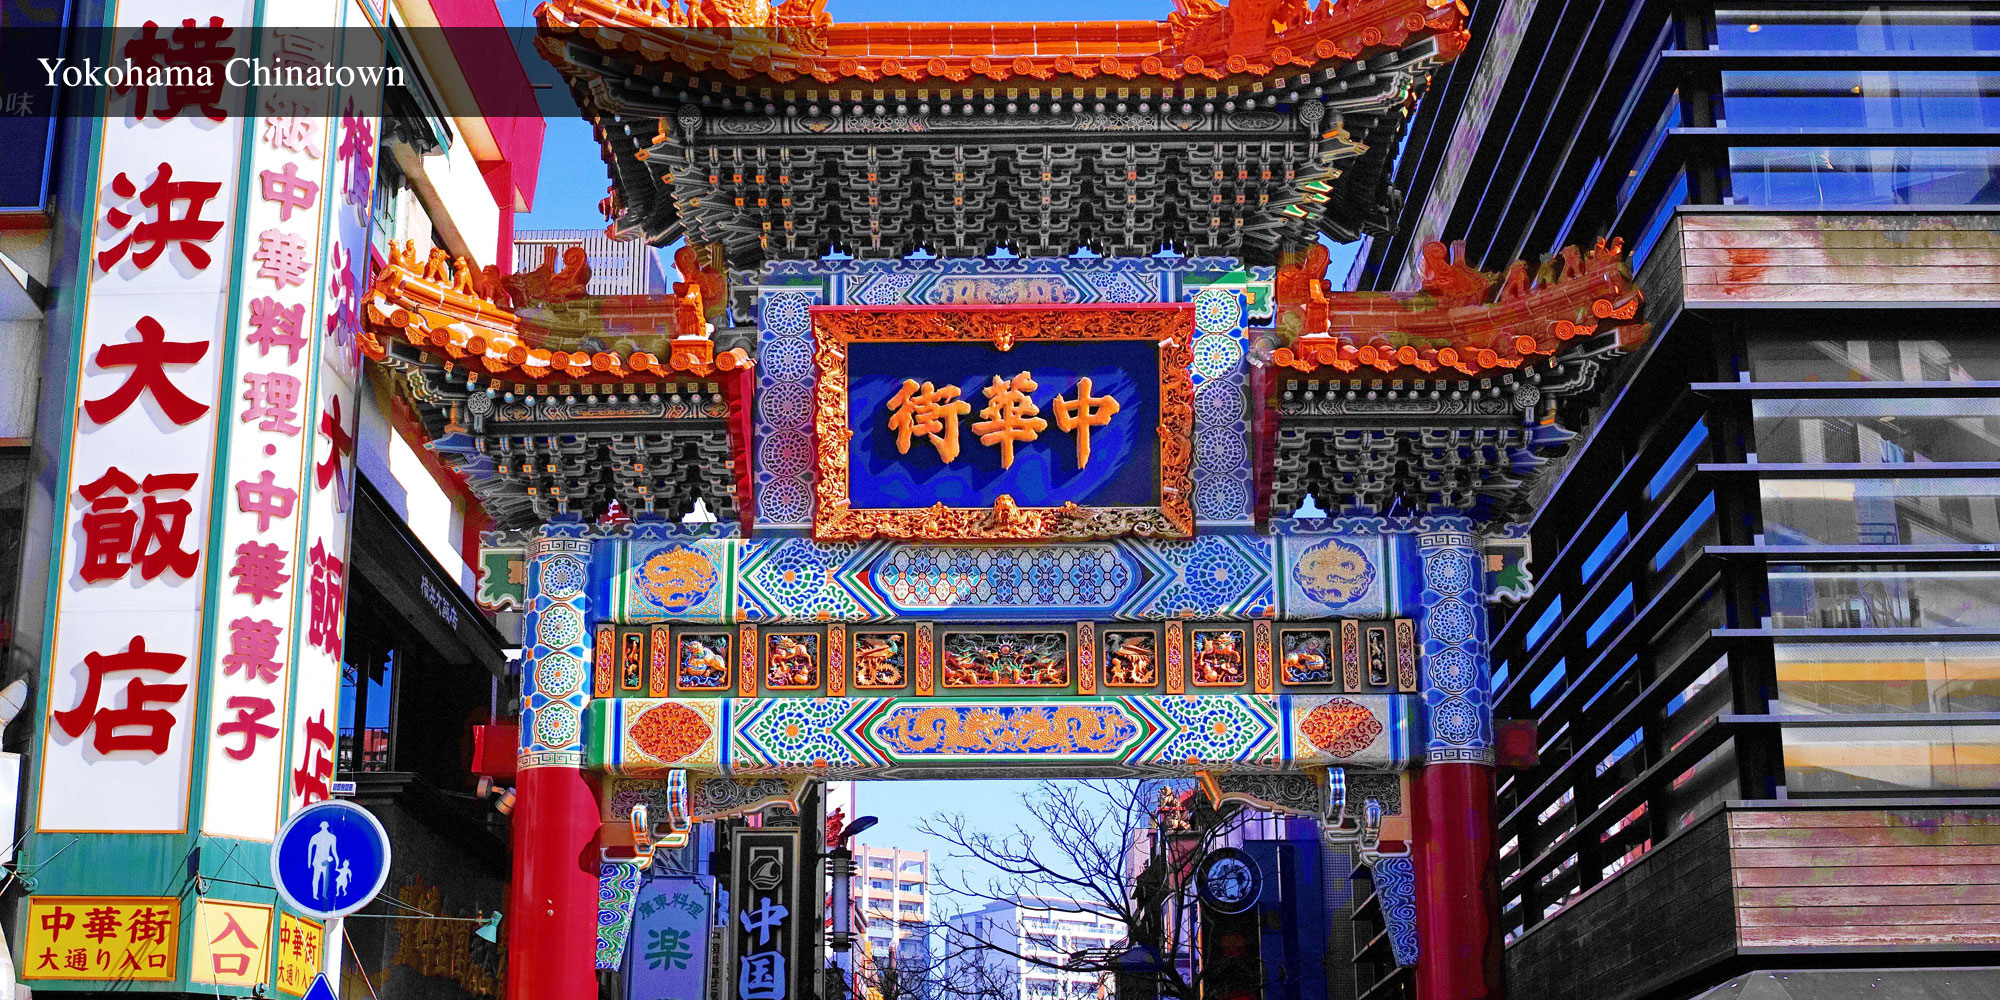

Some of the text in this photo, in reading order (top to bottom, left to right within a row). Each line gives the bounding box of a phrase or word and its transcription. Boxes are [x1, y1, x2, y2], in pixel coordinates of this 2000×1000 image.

[0, 91, 34, 117] 味
[54, 16, 237, 757] 横浜大飯店
[216, 26, 326, 761] 高級中華料理・中華菓子
[294, 95, 375, 805] 横浜大飯店
[41, 906, 172, 945] 中華街
[638, 893, 704, 920] 廣東料理
[36, 947, 167, 971] 大通り入口
[210, 912, 259, 976] 入口
[280, 920, 317, 966] 中華街
[645, 927, 693, 971] 楽
